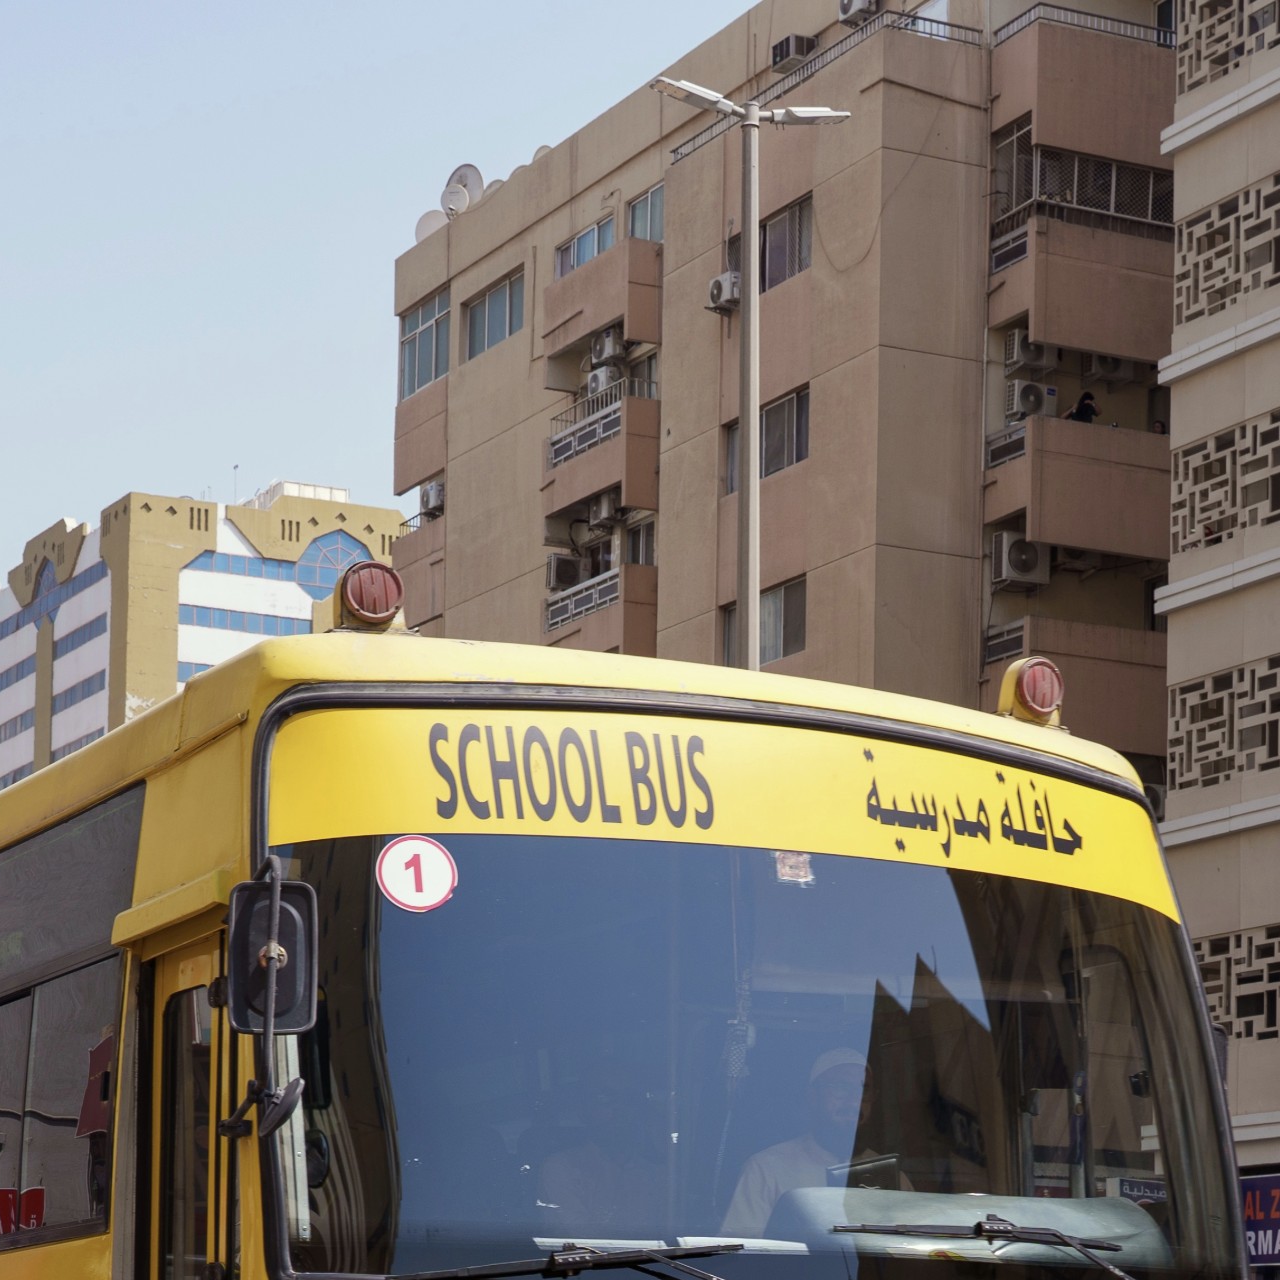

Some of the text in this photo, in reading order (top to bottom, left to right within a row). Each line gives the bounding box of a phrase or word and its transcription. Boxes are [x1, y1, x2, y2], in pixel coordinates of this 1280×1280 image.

[429, 720, 715, 831] SCHOOL BUS
[866, 748, 1083, 858] حافلة مدرسية
[404, 854, 426, 894] 1
[1244, 1190, 1264, 1221] AL
